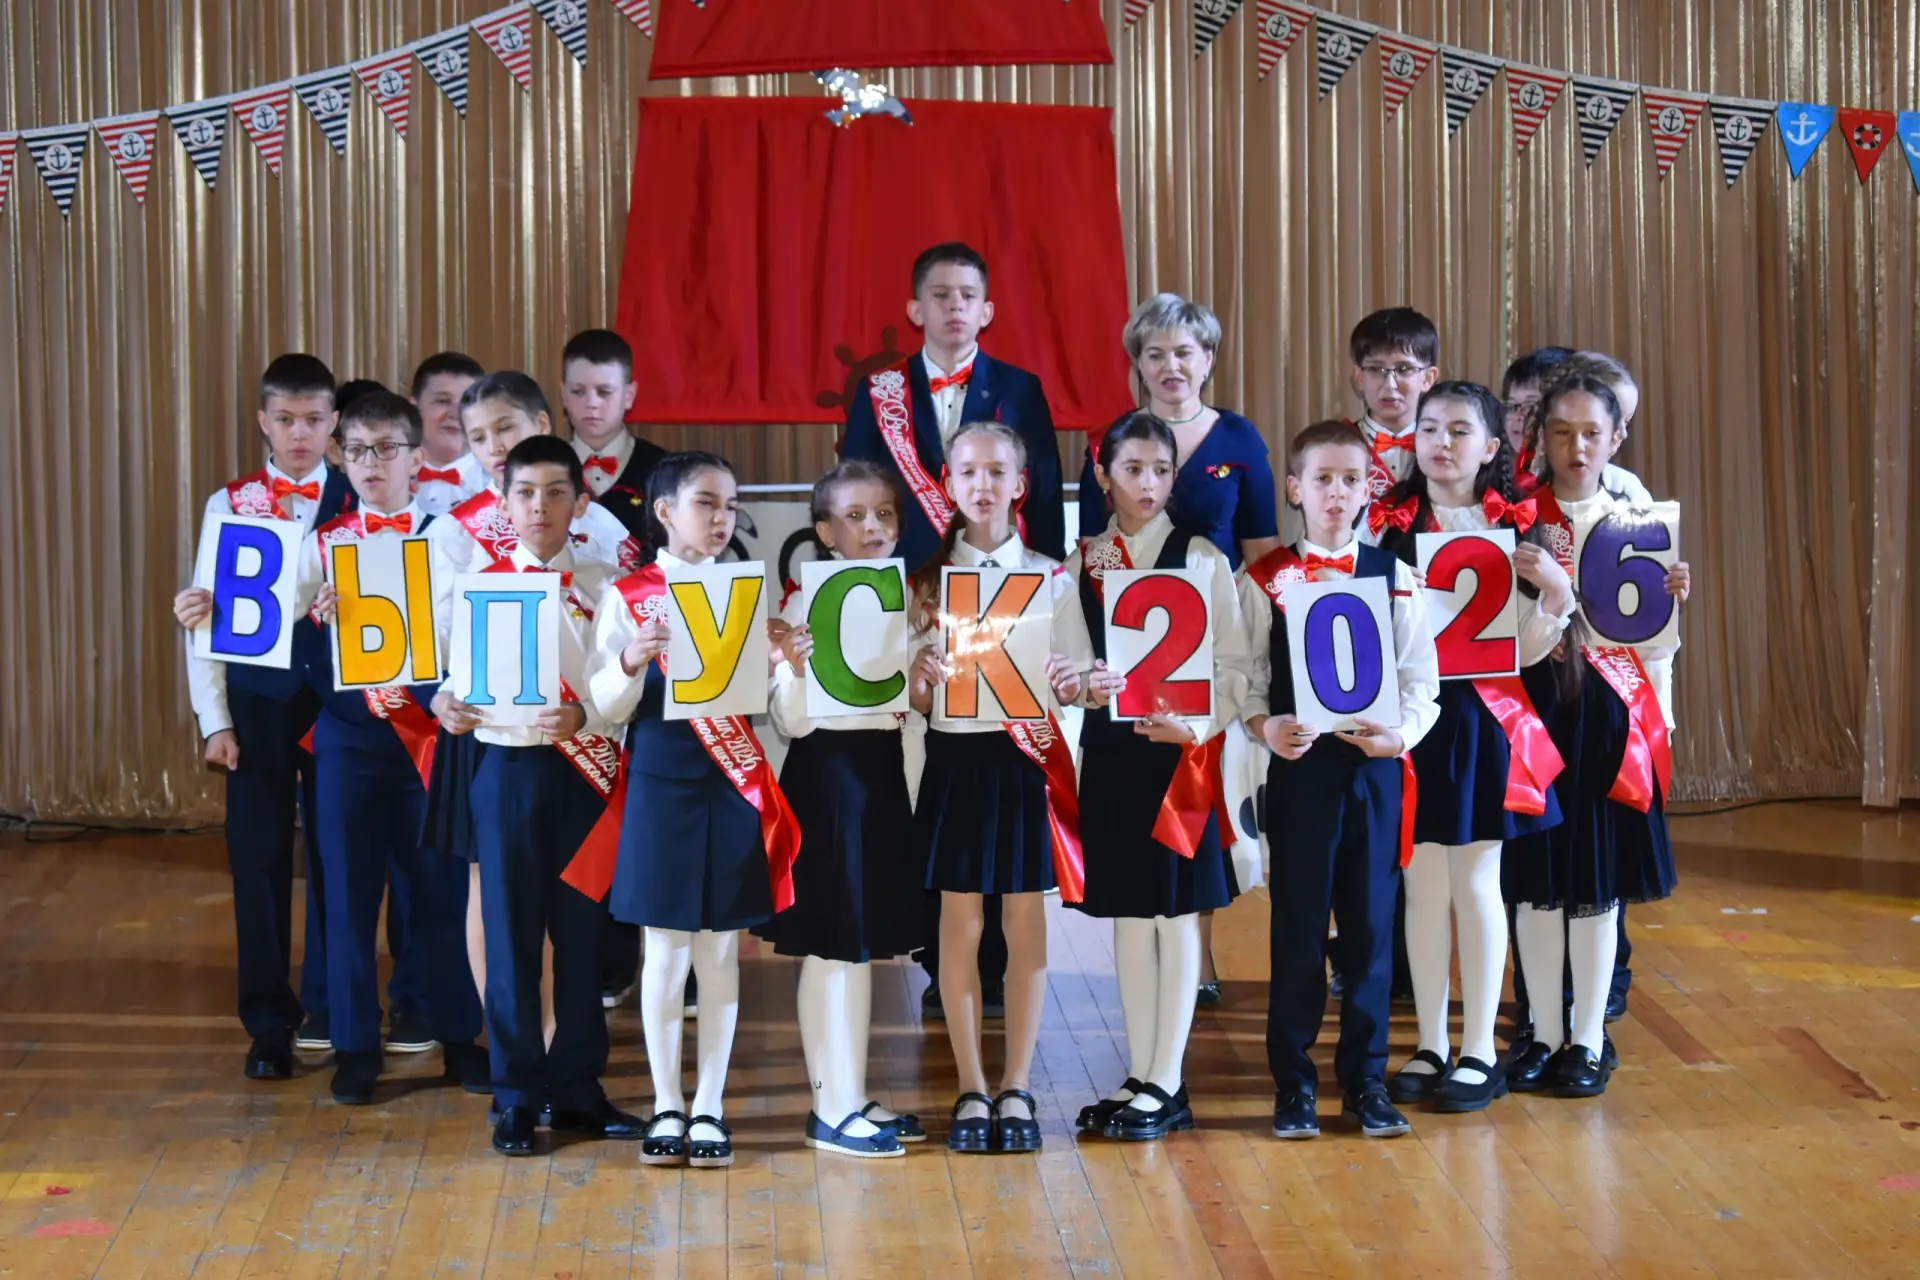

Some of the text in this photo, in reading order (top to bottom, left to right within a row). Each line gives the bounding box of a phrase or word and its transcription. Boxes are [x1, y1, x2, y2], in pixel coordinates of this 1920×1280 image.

[210, 511, 1675, 719] ВЫПУСК 2026
[574, 753, 612, 794] школы
[585, 744, 622, 778] 2026
[711, 743, 748, 787] школы
[724, 735, 763, 772] 2026
